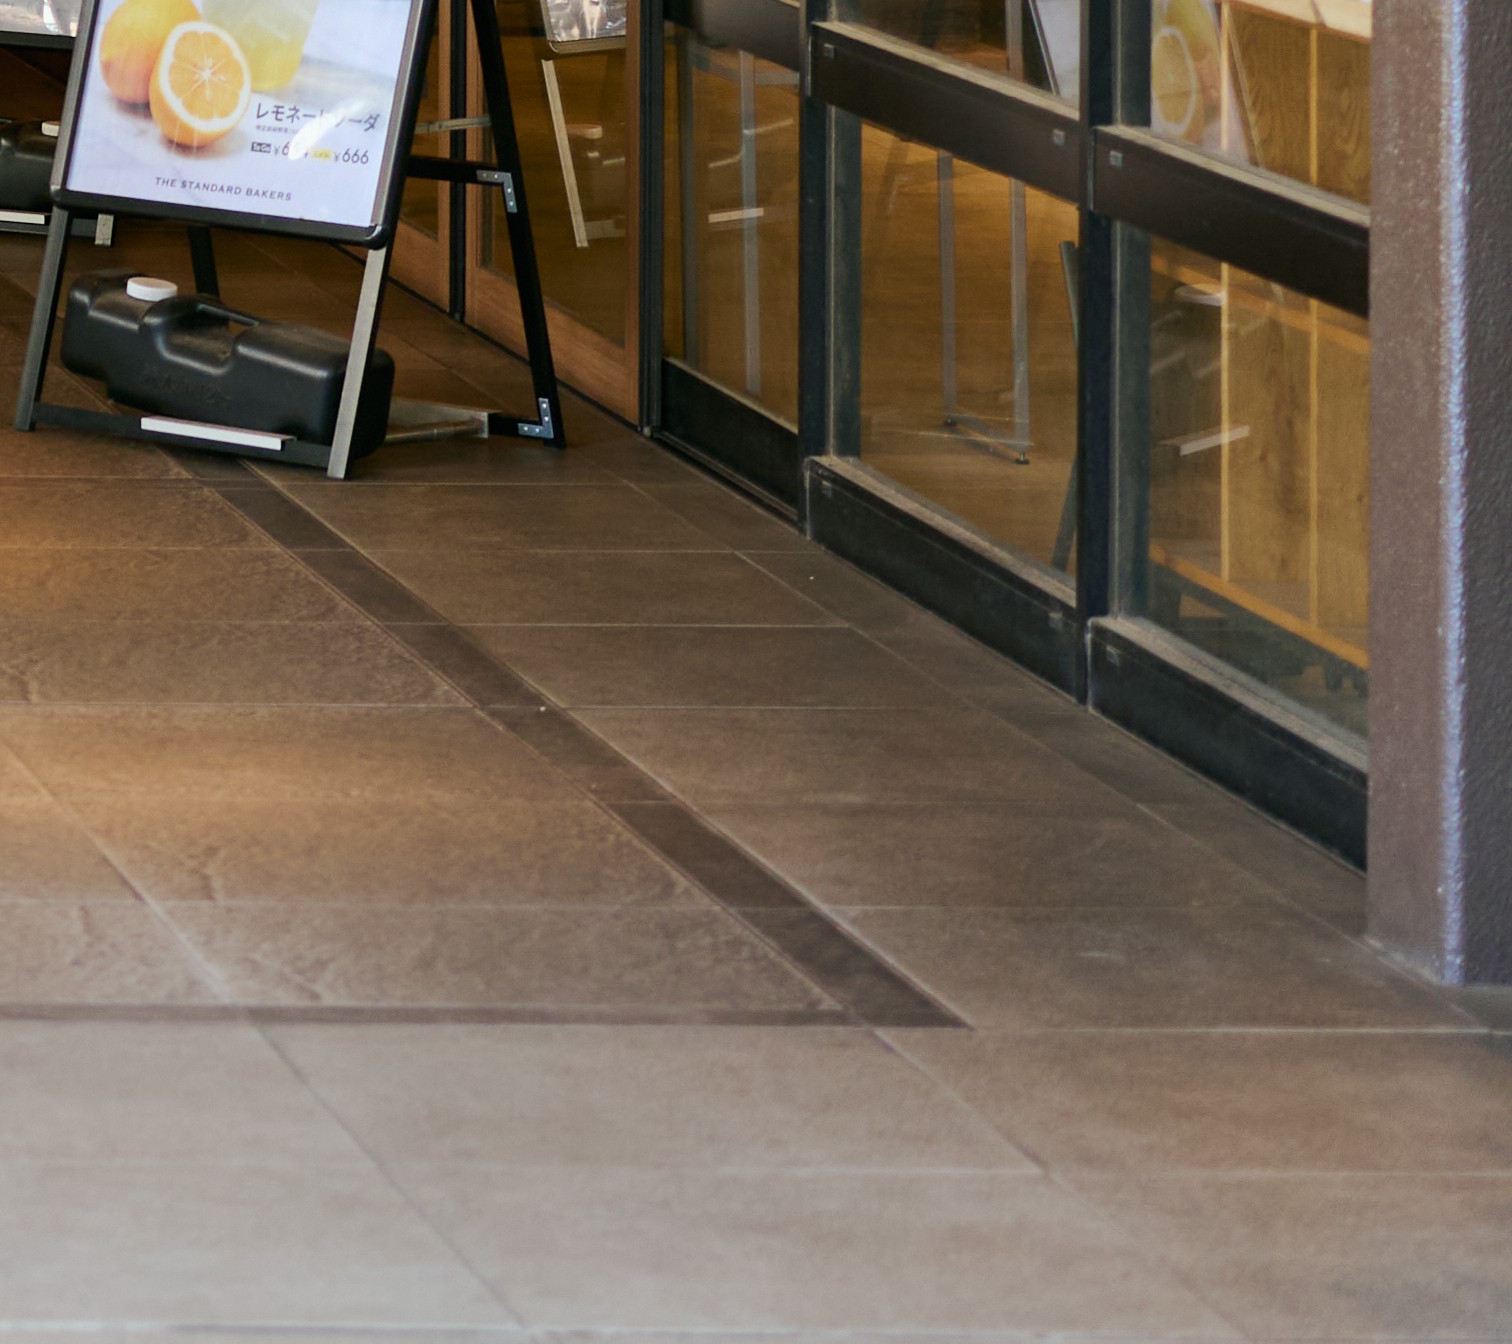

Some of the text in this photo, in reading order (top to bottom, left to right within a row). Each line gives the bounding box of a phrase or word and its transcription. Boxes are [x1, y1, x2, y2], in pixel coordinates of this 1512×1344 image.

[256, 103, 380, 131] レモネーーダ
[334, 148, 369, 165] ¥666
[155, 177, 292, 202] THE STANDARD BAKERS
